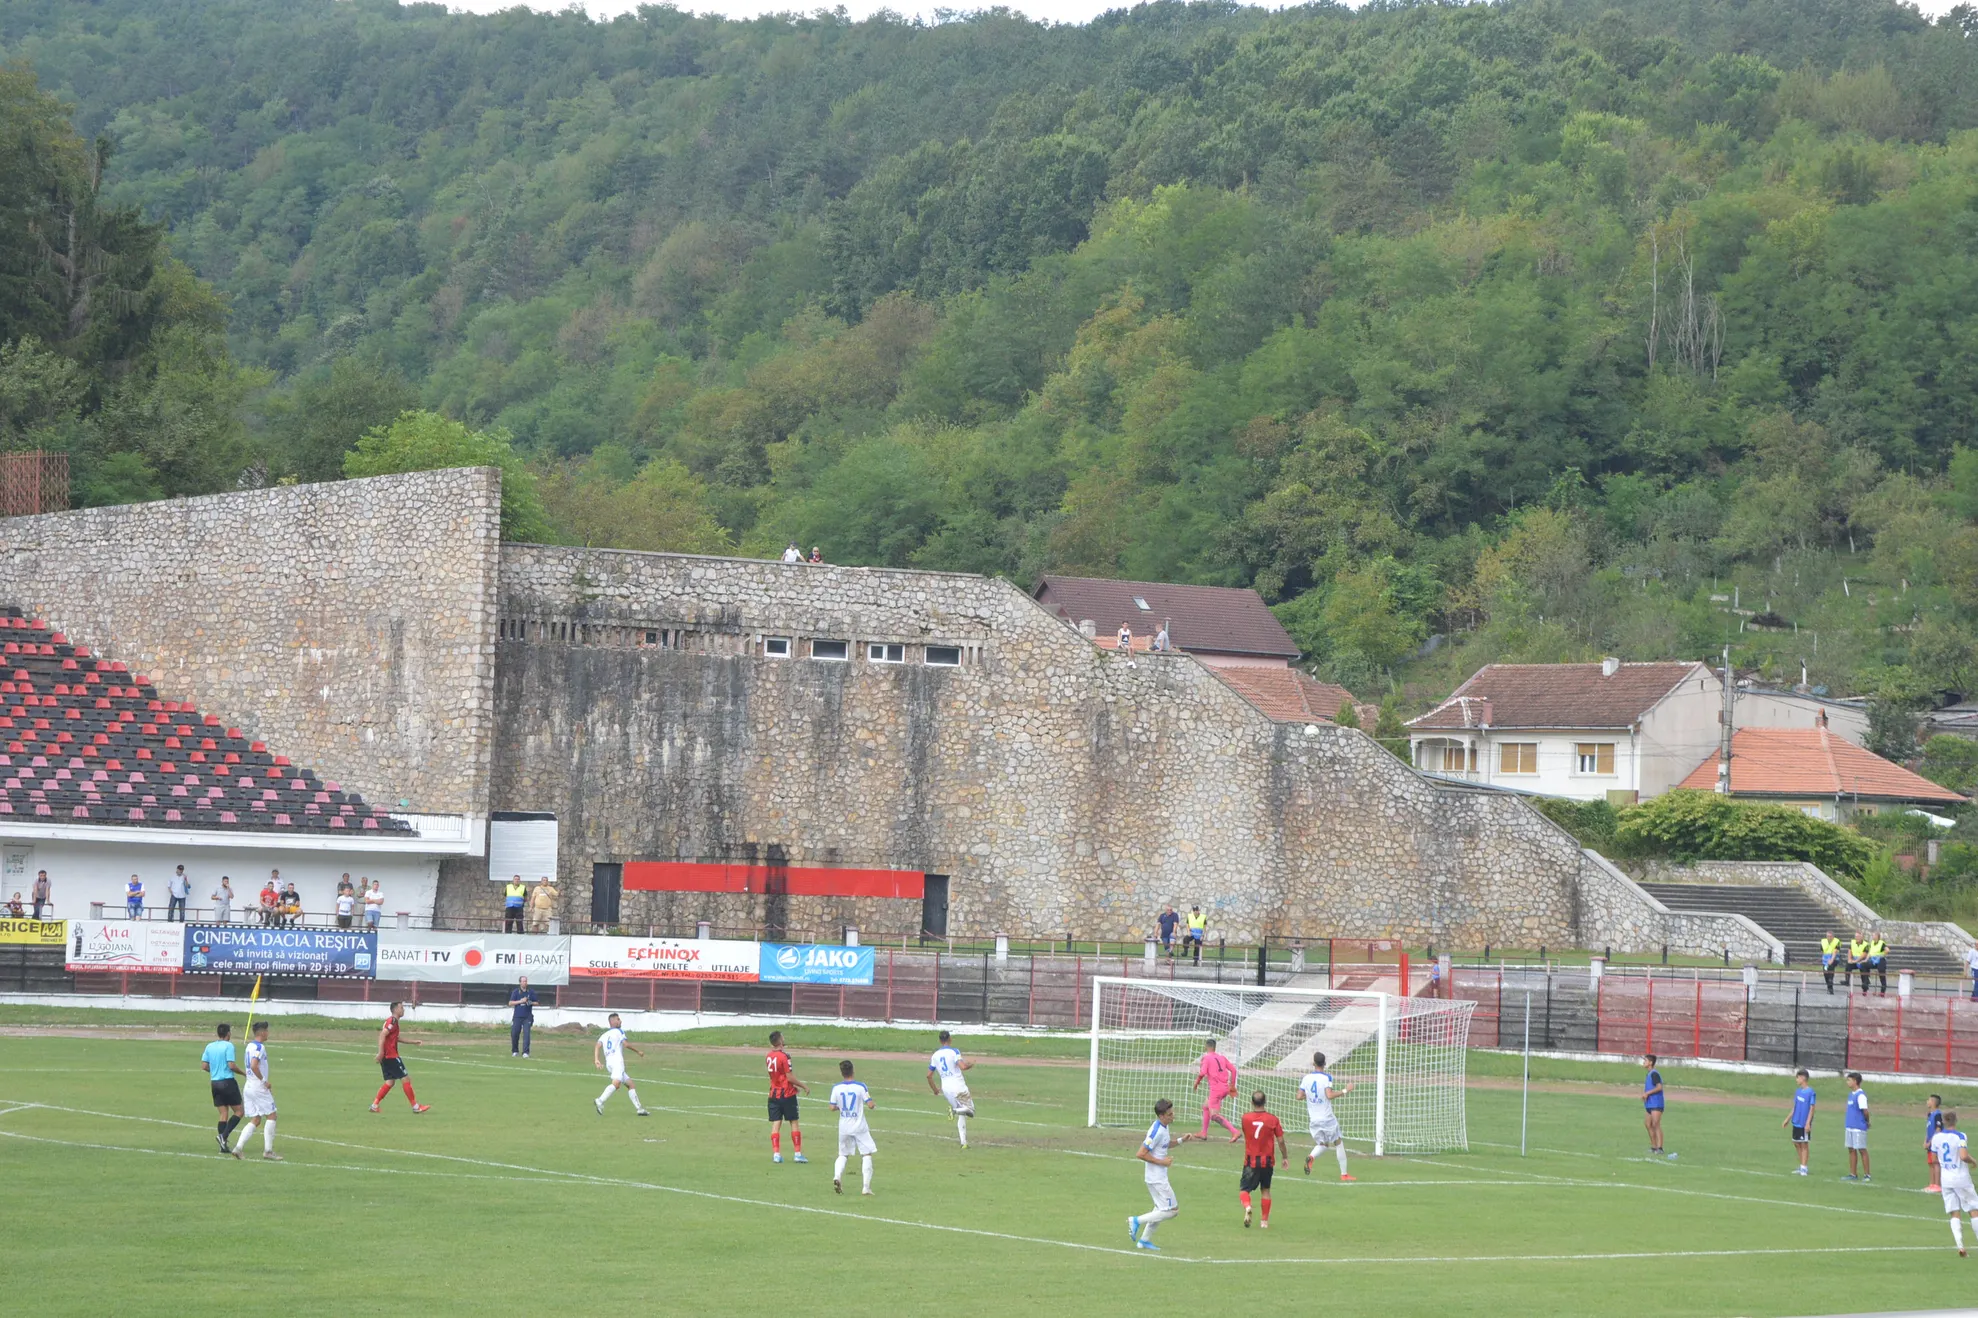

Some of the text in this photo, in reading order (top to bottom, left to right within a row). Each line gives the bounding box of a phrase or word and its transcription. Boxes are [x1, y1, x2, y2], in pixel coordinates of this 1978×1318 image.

[94, 925, 129, 942] Ana
[193, 930, 257, 946] CINEMA
[261, 932, 311, 947] DACIA
[381, 949, 451, 962] BANAT TV
[495, 953, 565, 965] FM BANAT
[627, 947, 700, 961] ECHINOX
[804, 949, 858, 968] JAKO
[213, 960, 233, 969] cele
[235, 960, 252, 969] mai
[254, 960, 270, 970] noi
[272, 961, 295, 970] filme
[310, 962, 322, 971] 2D
[334, 963, 347, 972] 3D
[589, 960, 750, 973] SCULE UNELTE UTILAJE
[606, 1036, 612, 1049] 6
[766, 1057, 777, 1072] 21
[940, 1057, 948, 1071] 3
[1214, 1057, 1223, 1072] 1
[1311, 1081, 1318, 1098] 4
[840, 1091, 856, 1111] 17
[1252, 1121, 1264, 1139] 7
[1942, 1142, 1952, 1162] 2
[1166, 1198, 1172, 1207] 7
